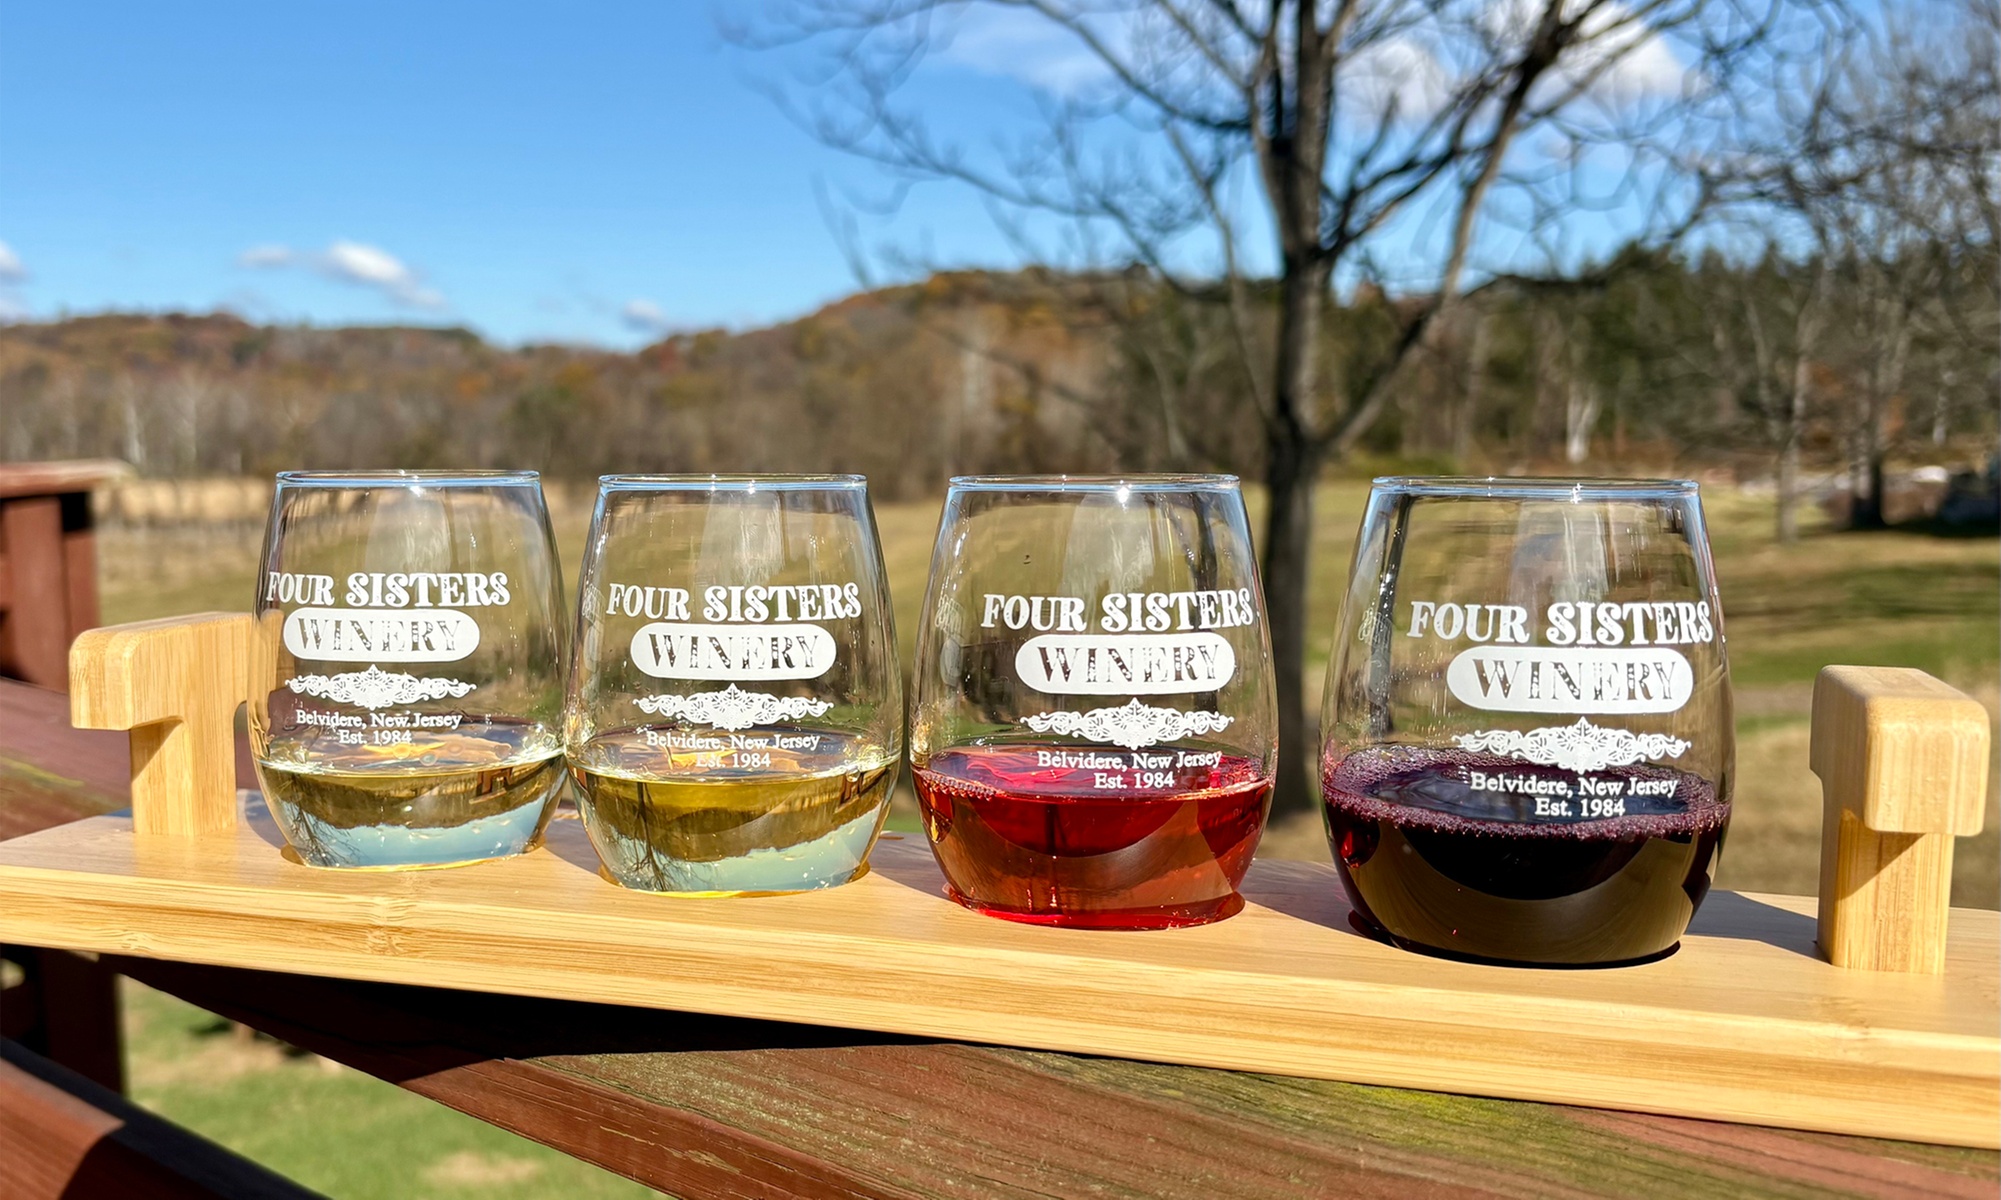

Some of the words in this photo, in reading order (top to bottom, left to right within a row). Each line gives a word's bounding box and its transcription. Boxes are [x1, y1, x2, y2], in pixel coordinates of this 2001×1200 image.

[266, 571, 335, 606] FOUR
[346, 571, 511, 607] SISTERS
[606, 583, 691, 621] FOUR
[703, 582, 862, 623] SISTERS
[980, 594, 1087, 632] FOUR
[1101, 588, 1254, 633] SISTERS
[1406, 601, 1530, 643] FOUR
[1546, 601, 1714, 645] SISTERS
[297, 617, 462, 652] WINERY
[648, 633, 819, 670] WINERY
[1037, 644, 1220, 683] WINERY
[1472, 658, 1677, 701] WINERY
[296, 710, 366, 728] Belvidere,
[370, 712, 410, 728] New
[412, 711, 463, 729] Jersey
[338, 730, 367, 745] Est.
[373, 730, 412, 745] 1984
[646, 731, 726, 751] Belvidere,
[730, 735, 770, 751] New
[772, 734, 821, 751] Jersey
[696, 753, 726, 768] Est.
[732, 753, 771, 768] 1984
[1037, 751, 1128, 772] Belvidere,
[1132, 753, 1173, 770] New
[1175, 751, 1222, 770] Jersey
[1093, 773, 1128, 789] Est.
[1134, 772, 1175, 789] 1984
[1470, 772, 1573, 796] Belvidere,
[1577, 777, 1624, 796] New
[1627, 777, 1678, 798] Jersey
[1534, 798, 1573, 816] Est.
[1580, 798, 1626, 817] 1984
